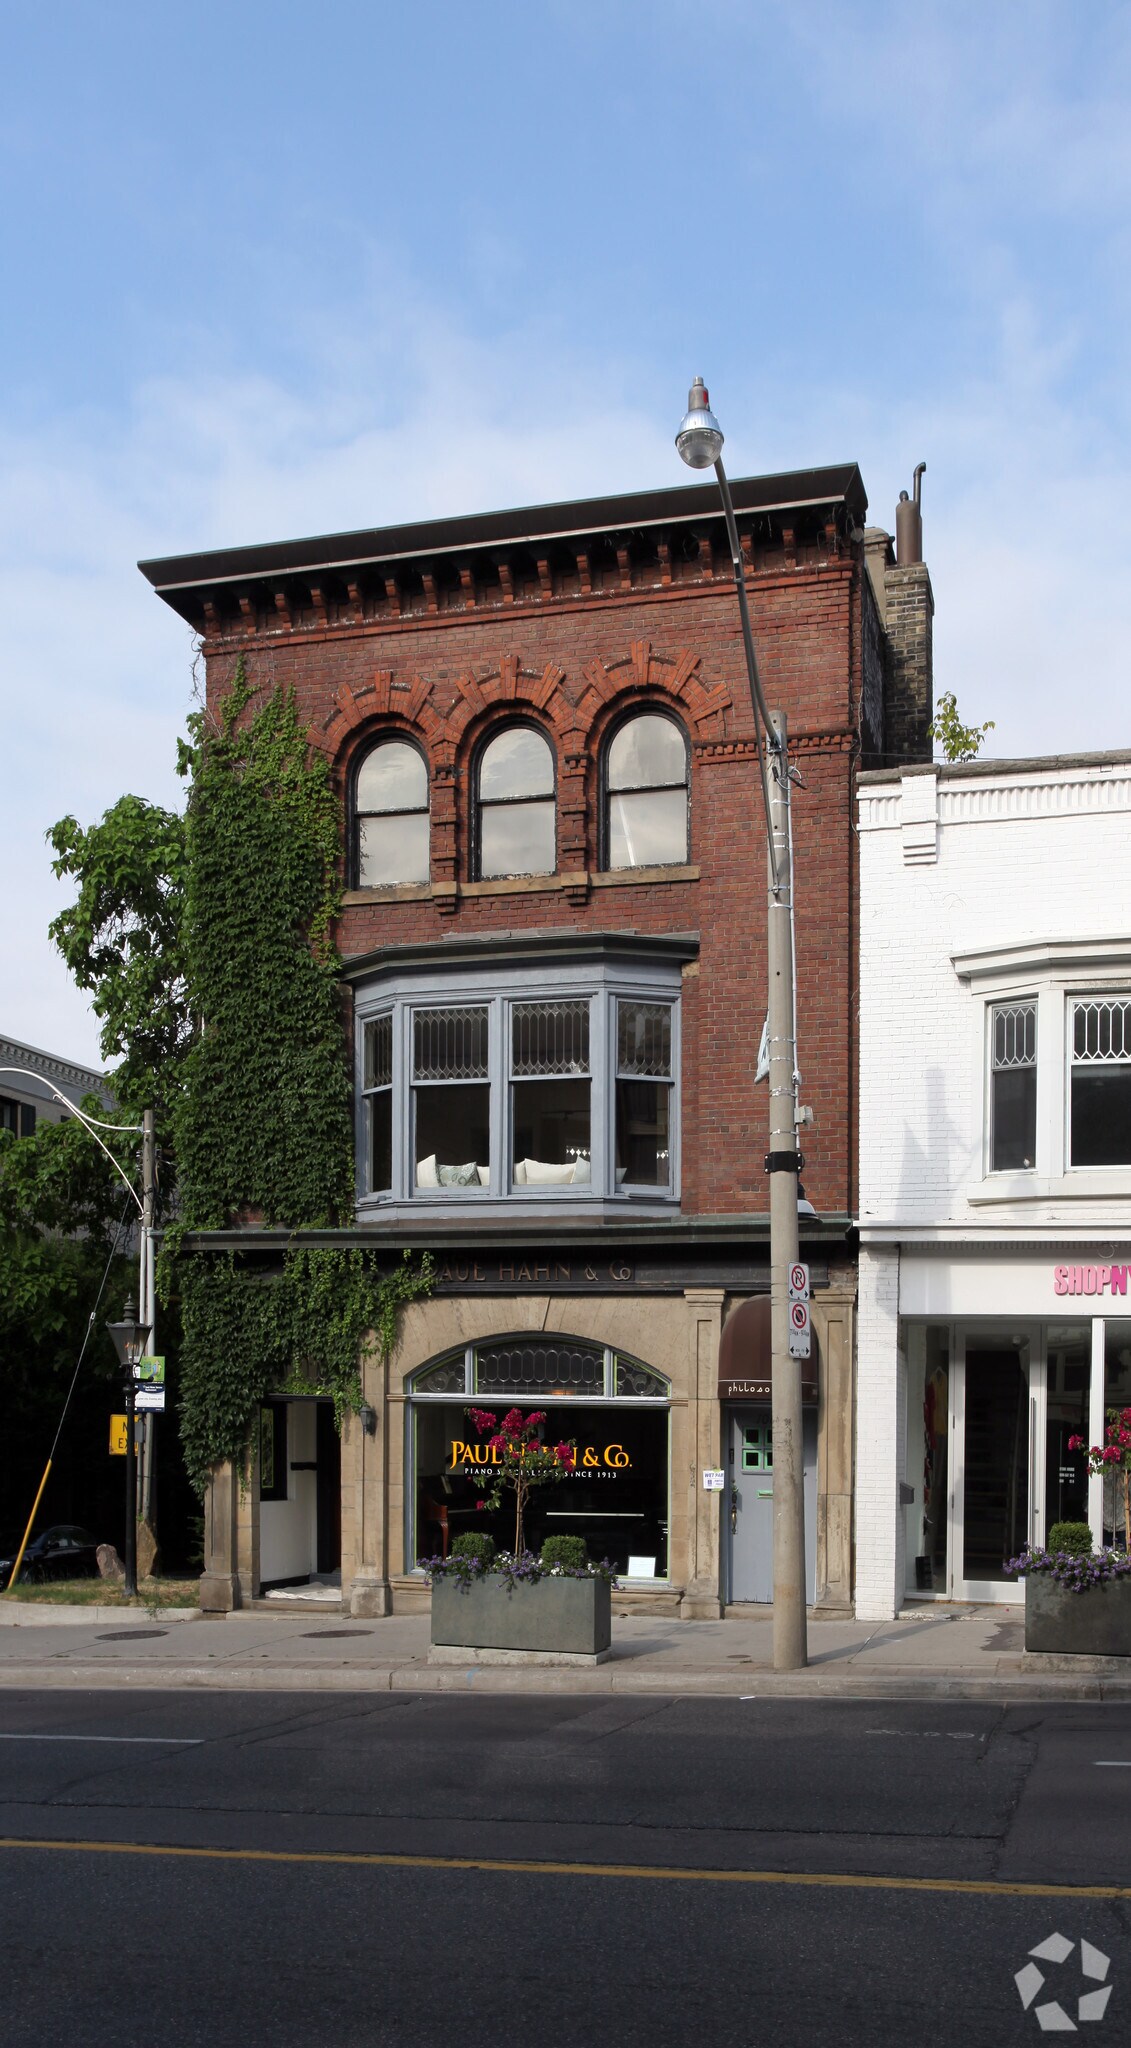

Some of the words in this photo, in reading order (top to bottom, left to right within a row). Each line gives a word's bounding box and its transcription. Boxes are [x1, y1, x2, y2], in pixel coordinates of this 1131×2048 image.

[499, 1262, 572, 1281] HAHN
[584, 1263, 599, 1281] &
[450, 1441, 502, 1469] PAUL
[582, 1447, 602, 1467] &
[464, 1467, 493, 1475] PIANO
[564, 1470, 592, 1478] SINCE
[597, 1471, 617, 1479] 1913
